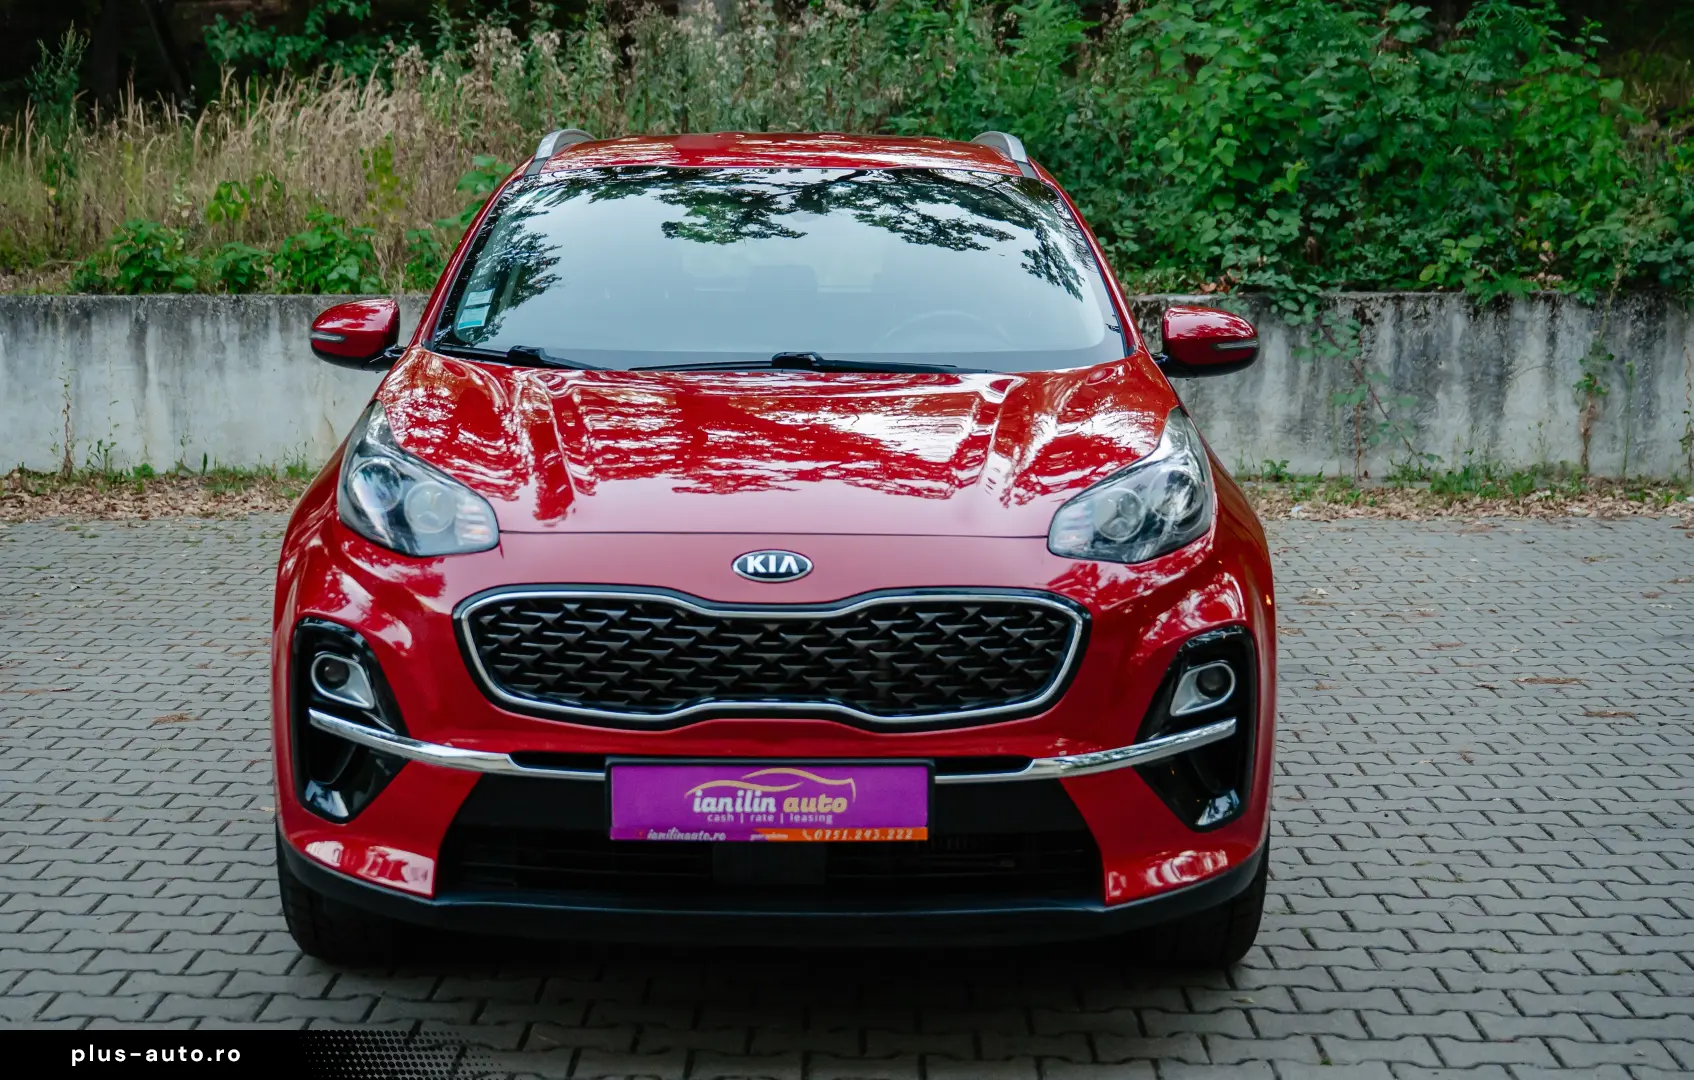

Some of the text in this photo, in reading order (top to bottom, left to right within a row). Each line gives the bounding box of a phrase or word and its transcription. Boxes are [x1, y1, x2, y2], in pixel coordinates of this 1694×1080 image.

[746, 554, 800, 574] KIA
[693, 789, 848, 813] ianilin auto
[707, 813, 734, 822] cash
[750, 814, 775, 822] rate
[789, 813, 833, 825] leasing
